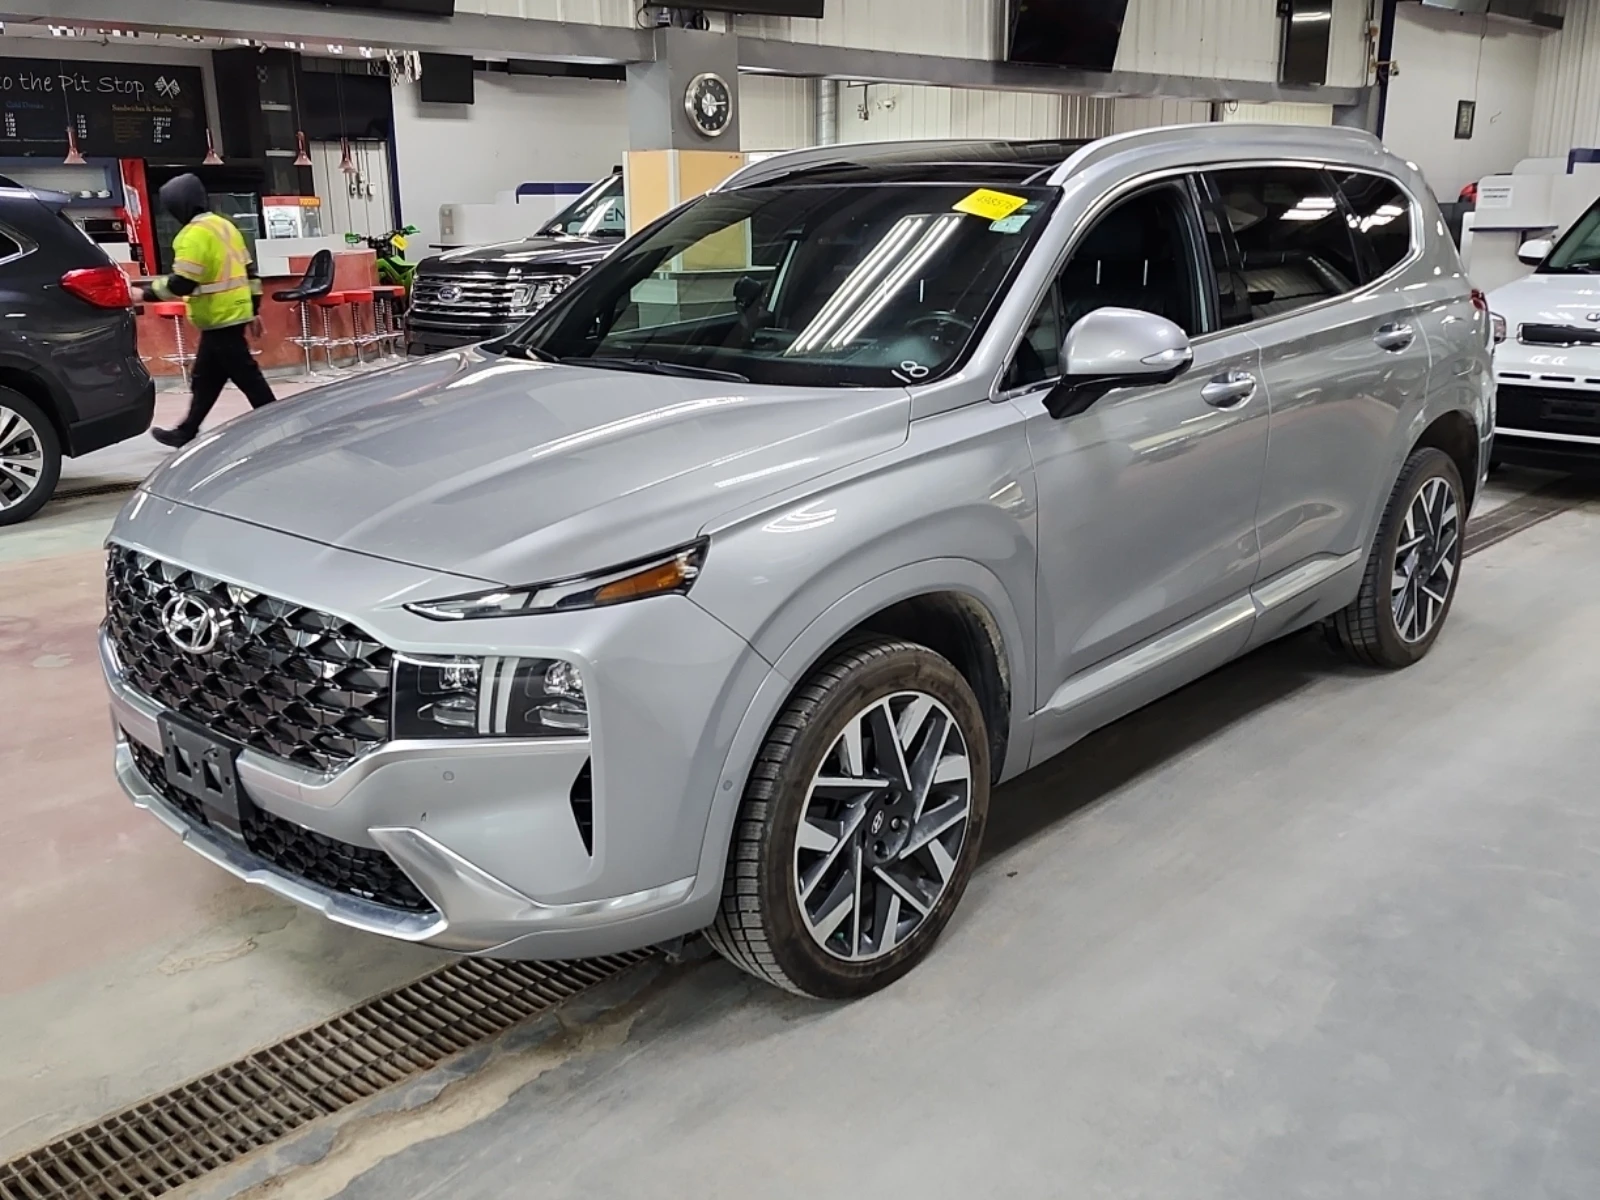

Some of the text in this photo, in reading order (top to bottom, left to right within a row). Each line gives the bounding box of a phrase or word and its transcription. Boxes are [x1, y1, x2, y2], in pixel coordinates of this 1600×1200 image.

[0, 72, 145, 101] o the Pit Stop
[891, 360, 929, 383] 18
